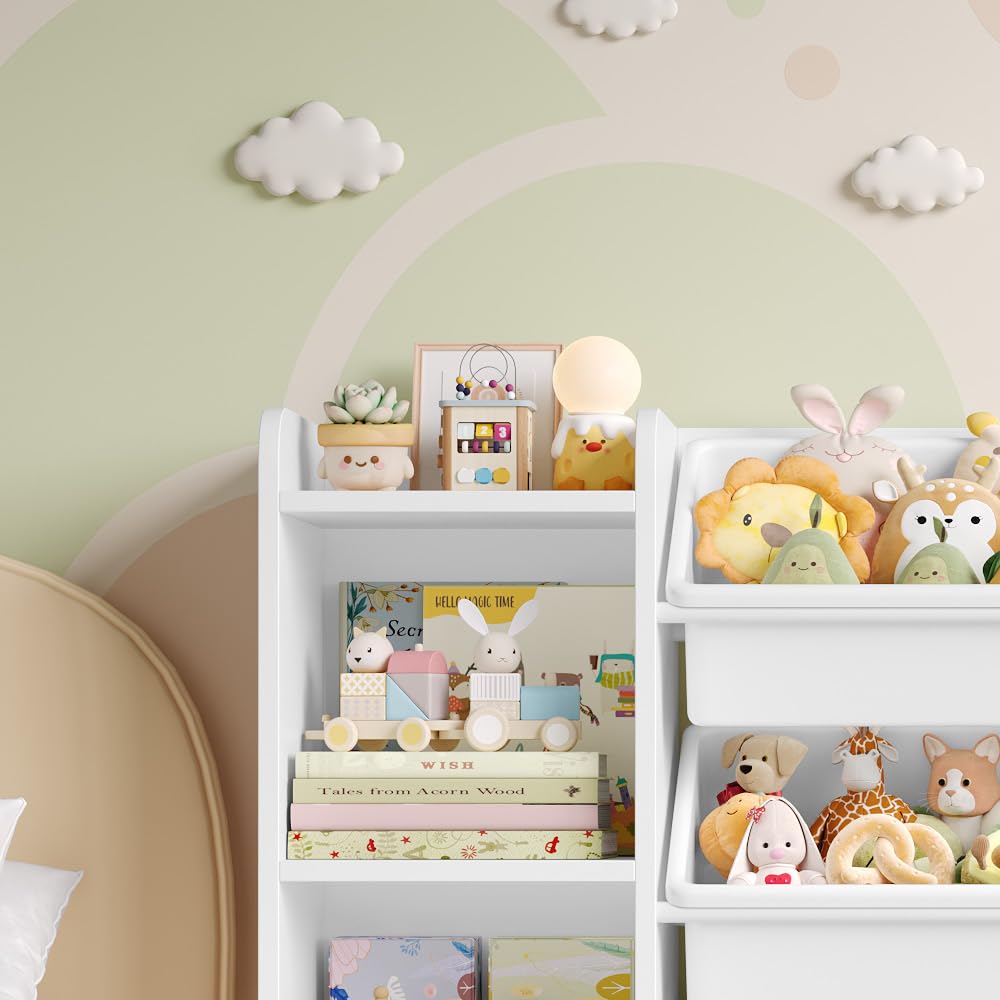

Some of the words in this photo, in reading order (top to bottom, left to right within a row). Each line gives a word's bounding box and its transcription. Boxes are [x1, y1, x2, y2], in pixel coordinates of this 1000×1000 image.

[480, 425, 488, 435] 2
[498, 426, 507, 438] 3
[495, 595, 515, 608] TIME
[420, 761, 475, 770] WISH
[317, 787, 363, 796] Tales
[370, 787, 411, 796] from
[417, 787, 469, 796] Acorn
[477, 787, 525, 796] Wood
